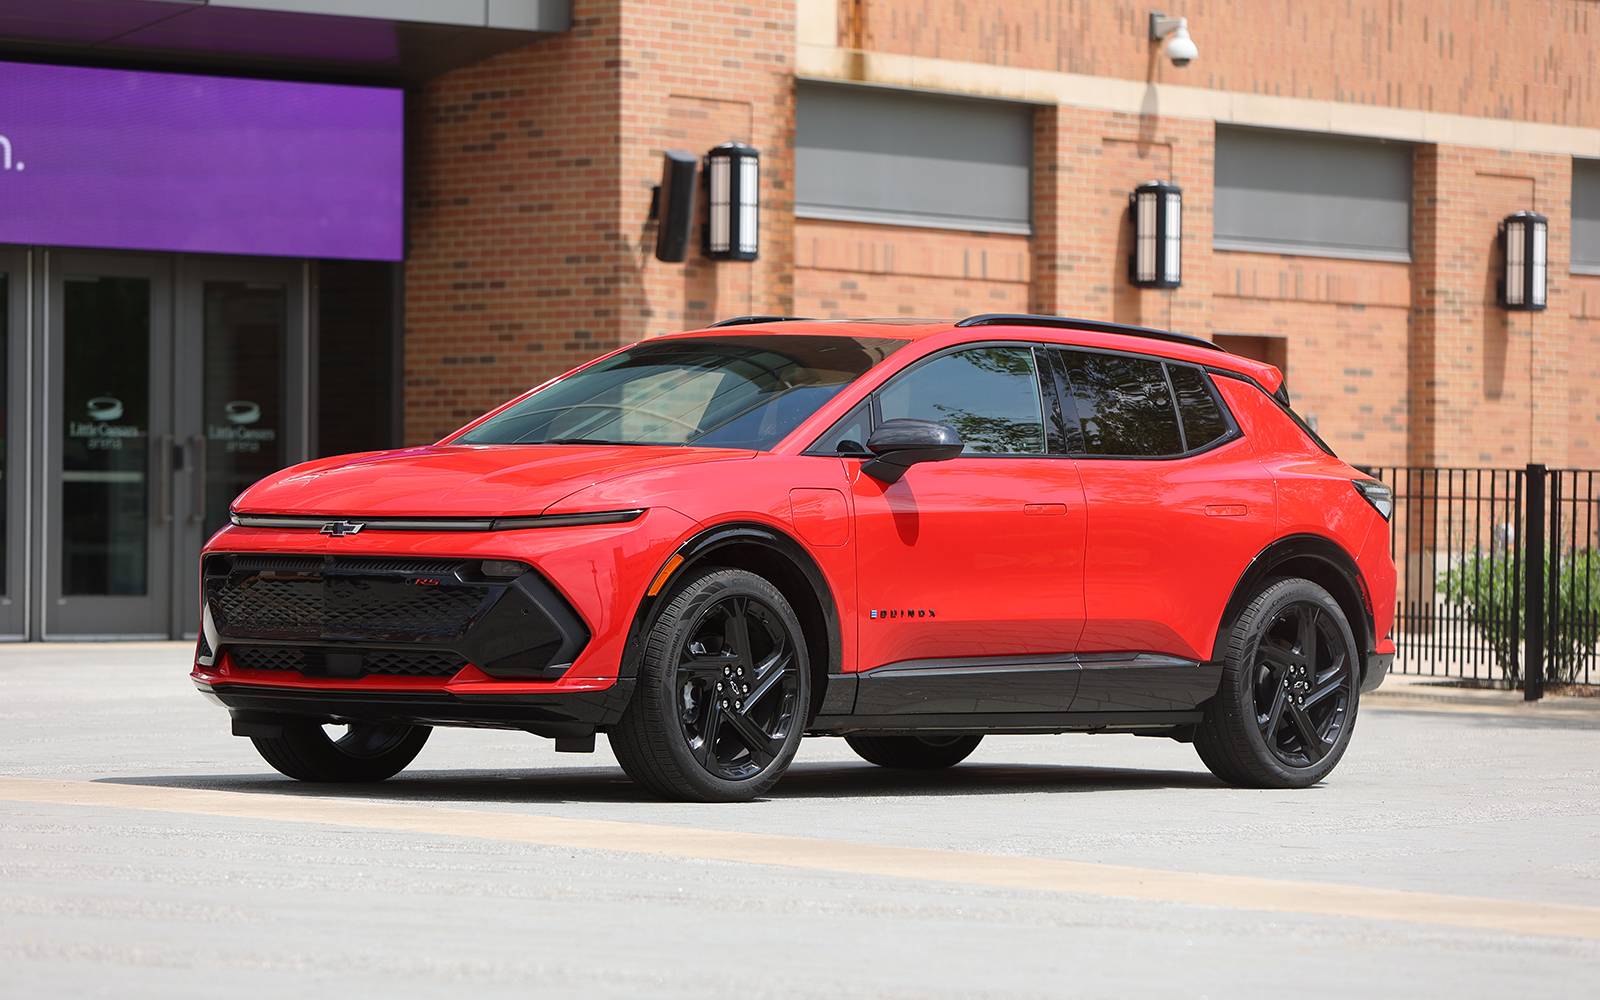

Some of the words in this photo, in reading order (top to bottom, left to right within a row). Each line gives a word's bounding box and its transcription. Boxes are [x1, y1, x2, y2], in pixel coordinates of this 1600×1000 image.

[88, 439, 122, 450] arena
[226, 440, 260, 453] arena
[415, 577, 440, 586] RS
[869, 609, 936, 620] EQUINOX
